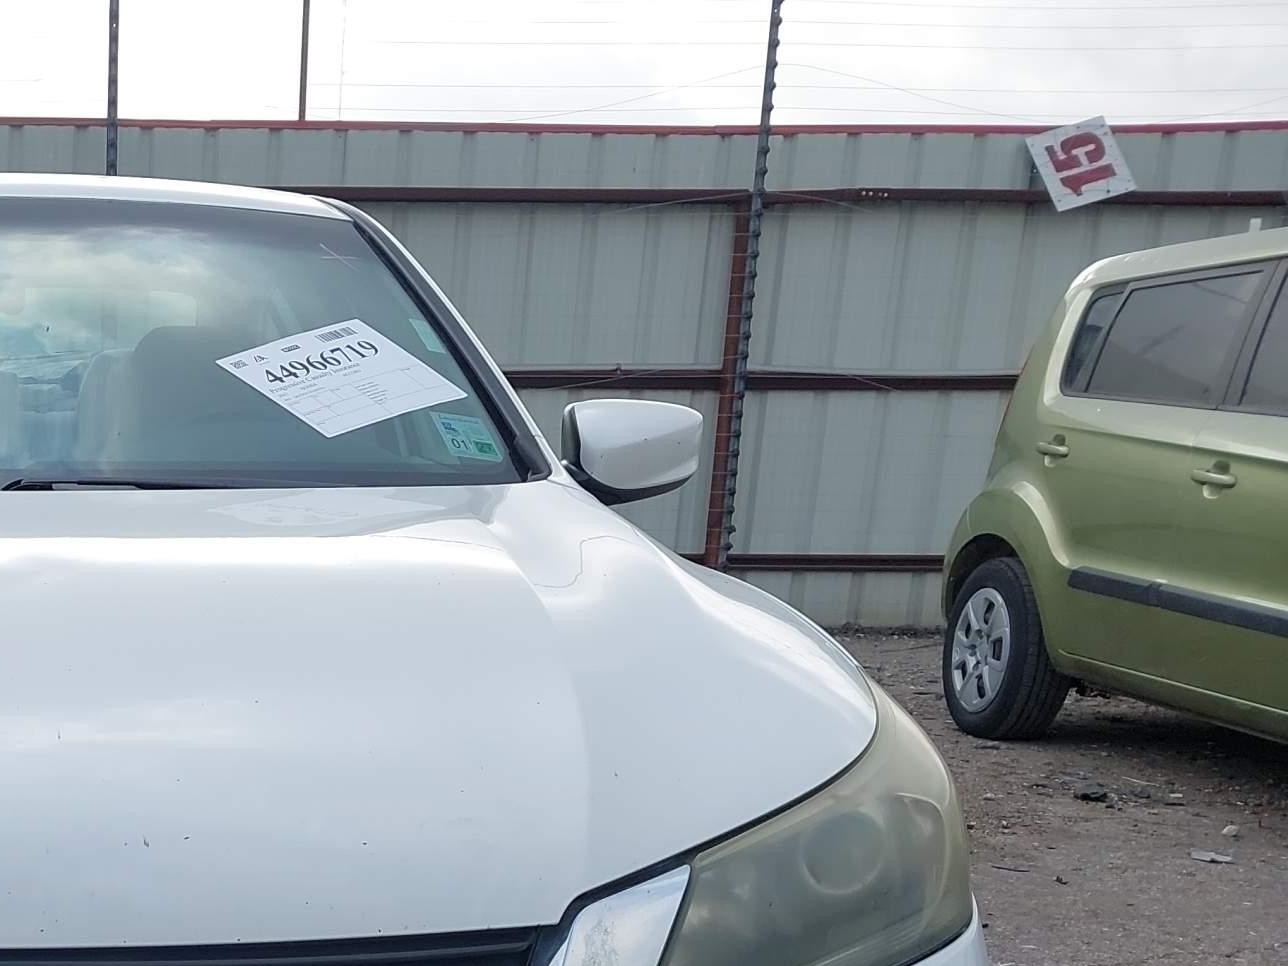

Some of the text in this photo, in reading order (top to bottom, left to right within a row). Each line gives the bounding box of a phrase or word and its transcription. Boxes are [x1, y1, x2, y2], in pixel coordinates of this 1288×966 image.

[1044, 131, 1118, 197] 15
[264, 340, 379, 383] 44966719
[451, 438, 470, 450] 01
